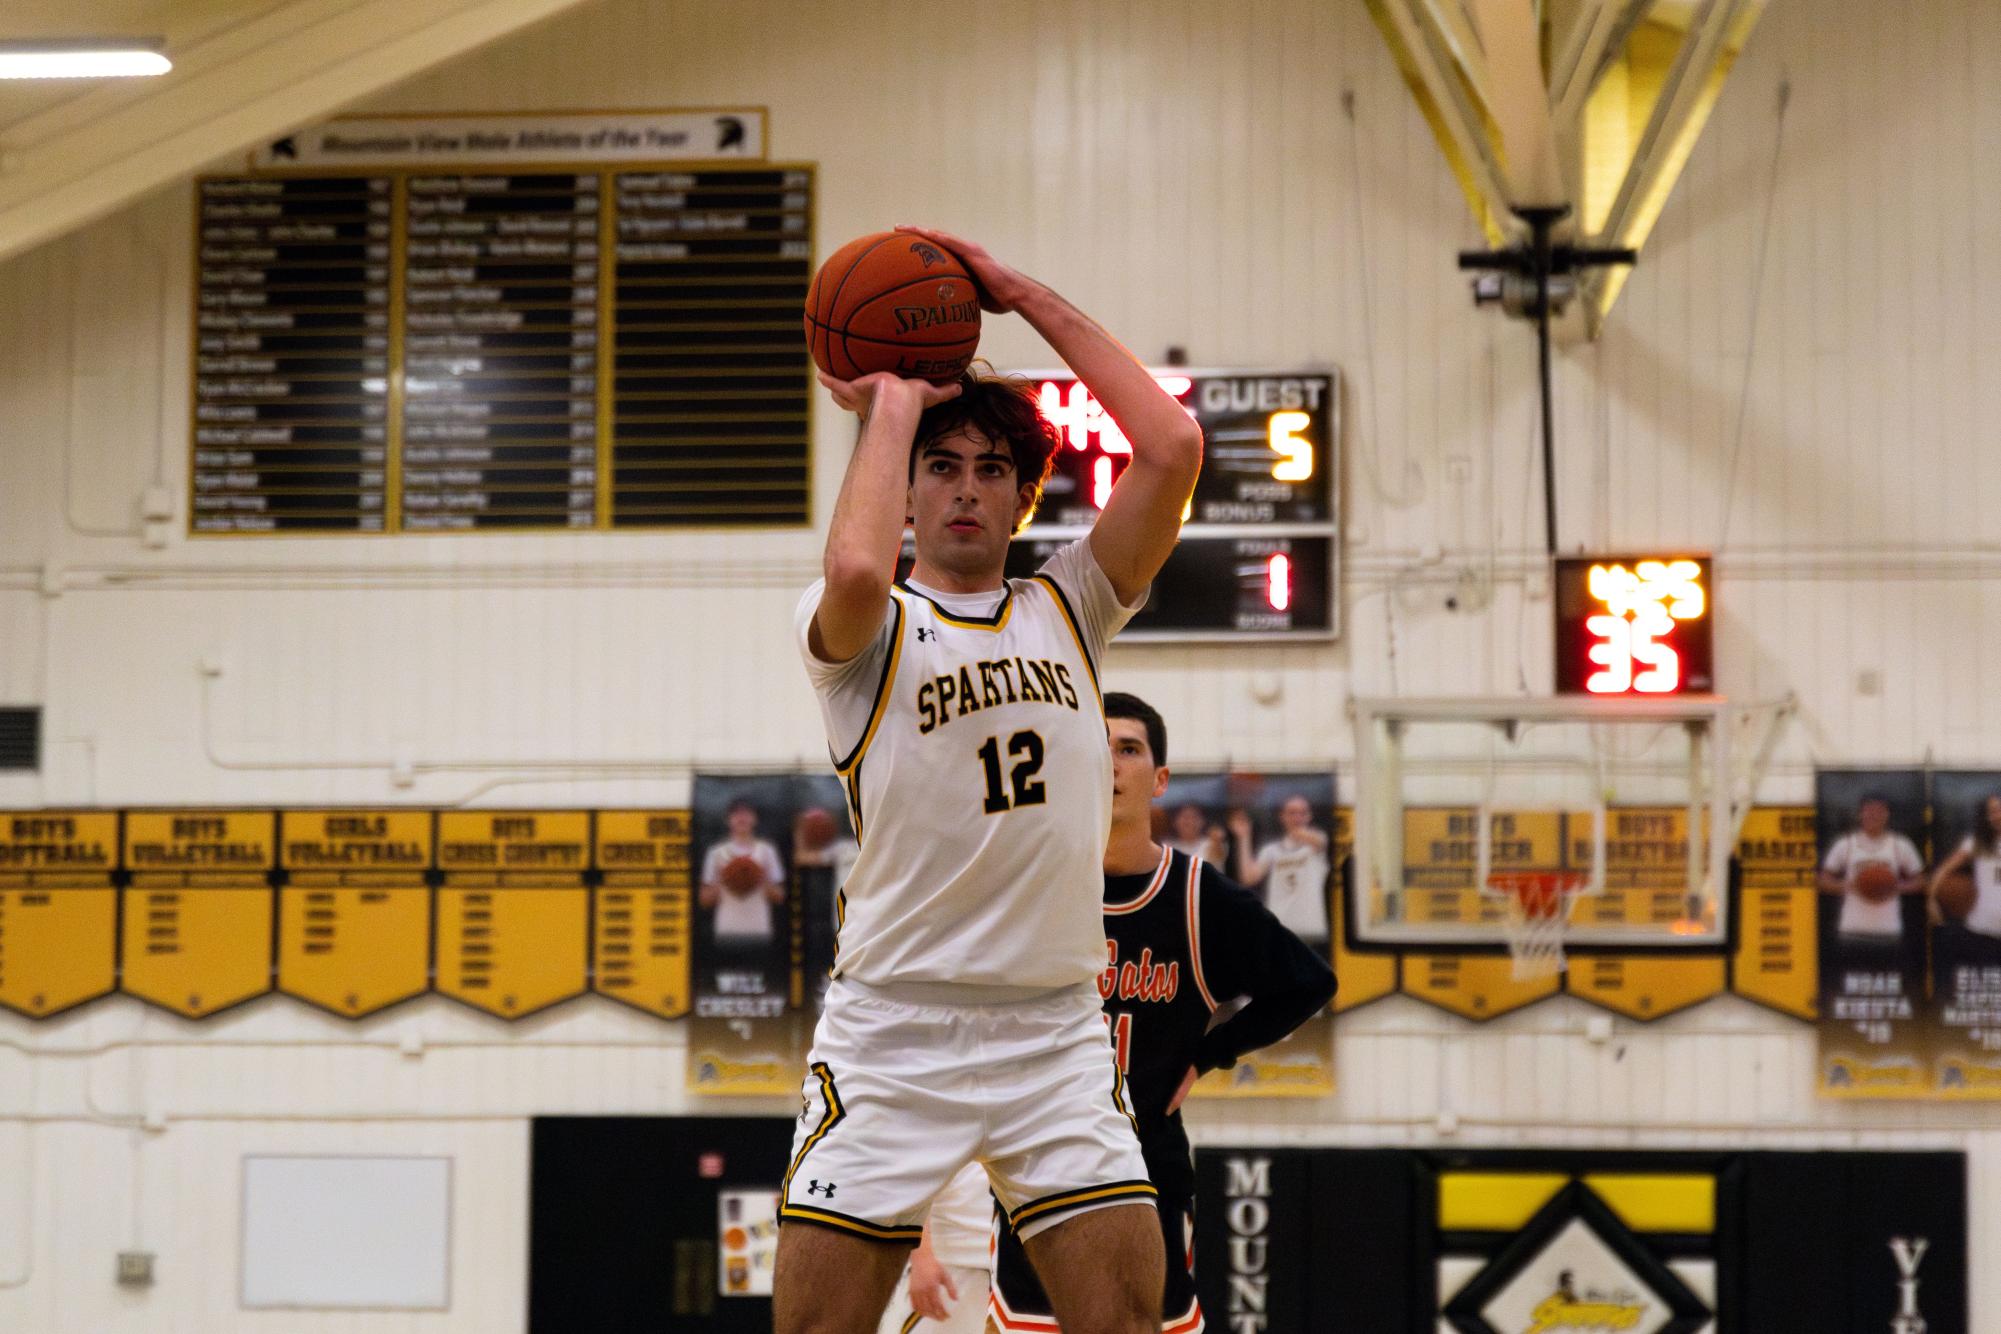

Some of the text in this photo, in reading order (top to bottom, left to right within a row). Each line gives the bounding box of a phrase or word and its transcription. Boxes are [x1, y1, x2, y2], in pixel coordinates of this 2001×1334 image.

[894, 300, 980, 335] SPALDIN
[1202, 379, 1327, 410] GUEST
[1269, 411, 1313, 481] 5
[1204, 503, 1276, 521] BONUS
[1269, 553, 1288, 610] 1
[1586, 615, 1679, 693] 35
[918, 656, 1079, 735] SPARTANS
[977, 729, 1046, 815] 12
[1097, 938, 1179, 1003] Gatos
